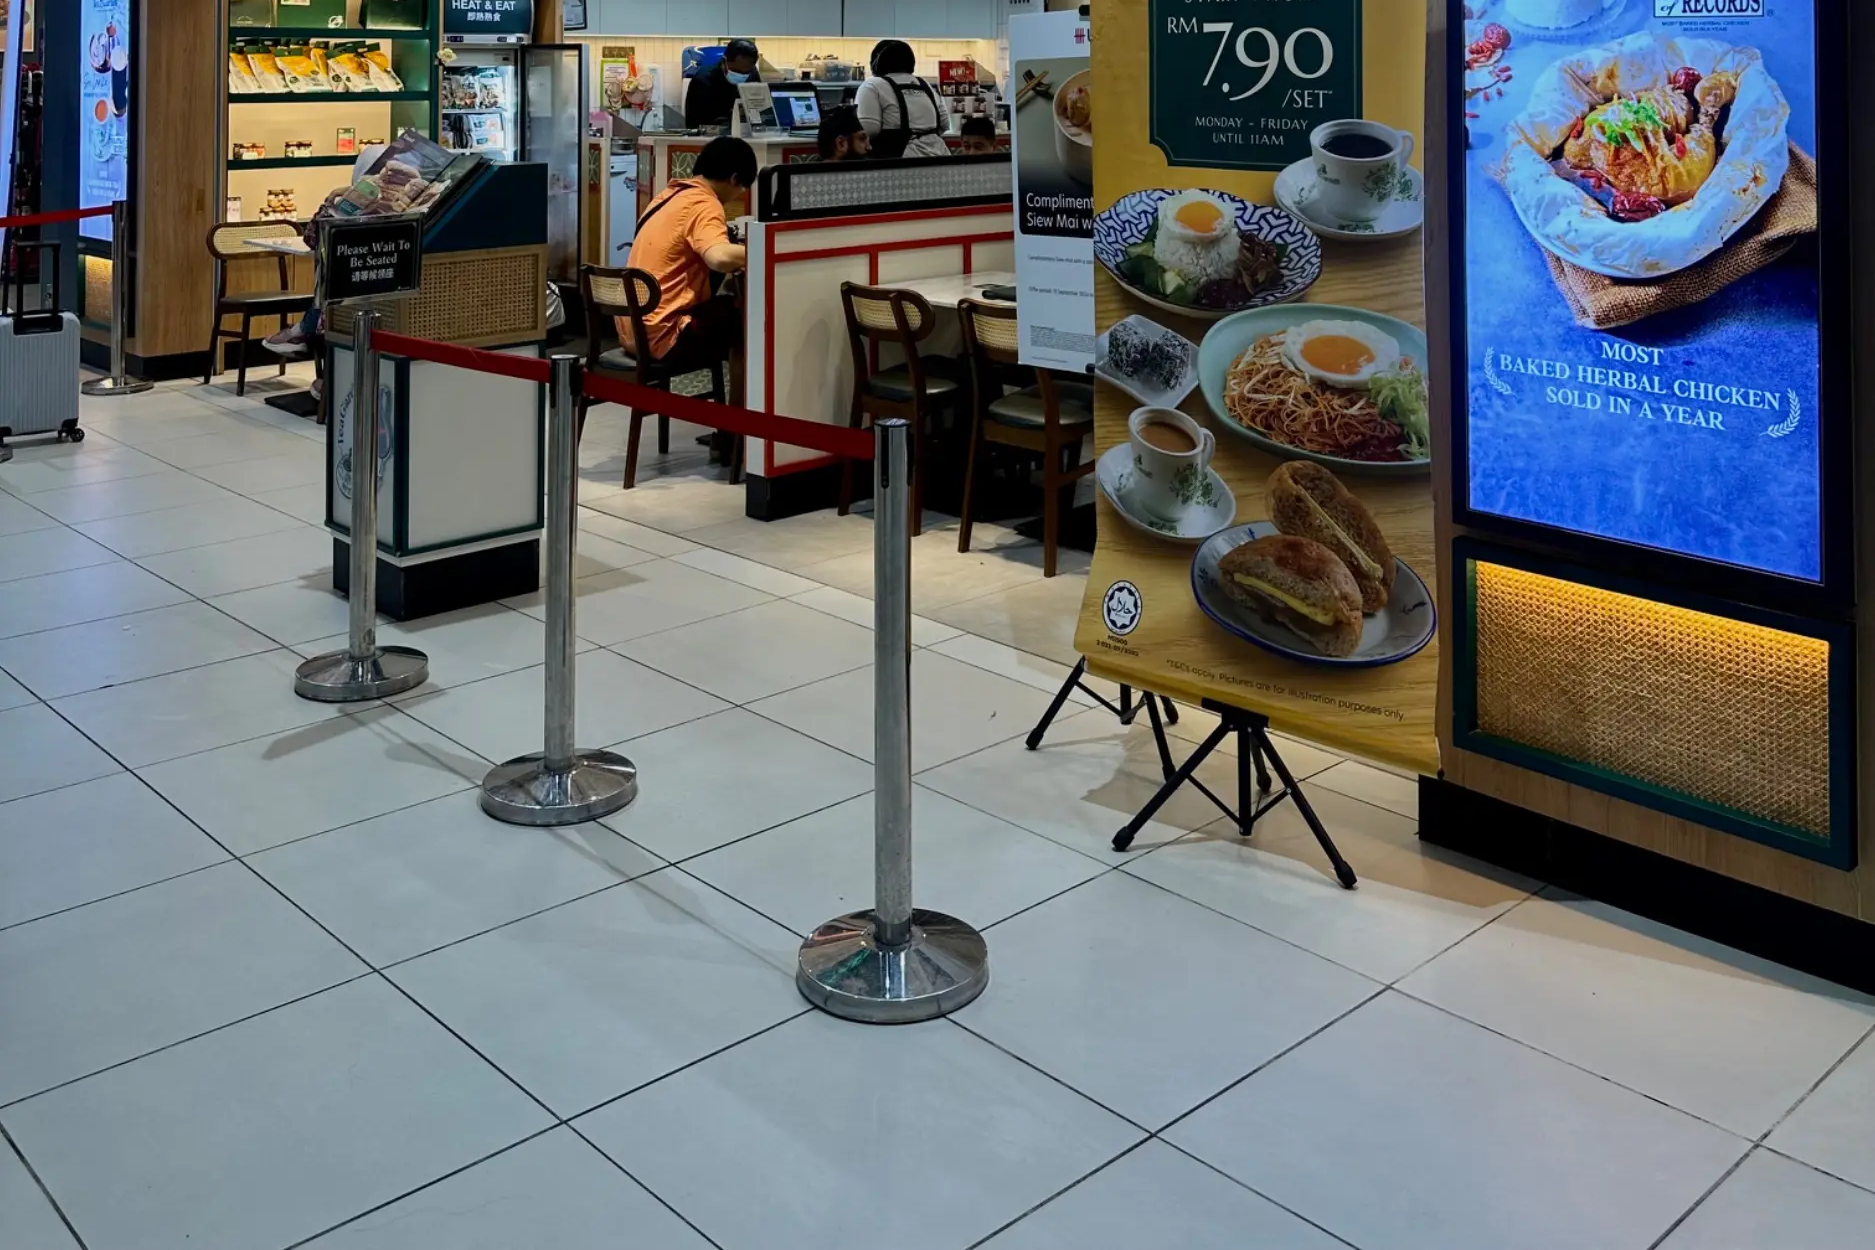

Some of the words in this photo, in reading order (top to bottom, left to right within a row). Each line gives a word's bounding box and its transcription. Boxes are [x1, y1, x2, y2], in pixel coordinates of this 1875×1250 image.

[452, 0, 482, 10] HEAT
[484, 0, 493, 10] &
[495, 0, 516, 11] EAT
[1167, 17, 1198, 34] RM
[1203, 22, 1334, 101] 7.90
[1195, 116, 1243, 128] MONDAY
[1261, 118, 1308, 130] FRIDAY
[1213, 133, 1244, 144] UNTIL
[1251, 135, 1284, 145] 11AM
[1026, 192, 1094, 211] Compliment
[1026, 212, 1053, 228] Siew
[1056, 214, 1079, 229] Mai
[337, 244, 369, 256] Please
[372, 241, 395, 252] Wait
[398, 240, 410, 250] To
[350, 257, 364, 268] Be
[366, 252, 398, 266] Seated
[1601, 341, 1664, 366] MOST
[1500, 354, 1570, 380] BAKED
[1578, 366, 1667, 394] HERBAL
[1673, 379, 1780, 411] CHICKEN
[1546, 386, 1601, 410] SOLD
[1609, 395, 1632, 415] IN
[1638, 399, 1655, 419] A
[1661, 404, 1725, 431] YEAR
[1218, 673, 1253, 688] Pictures
[1256, 682, 1270, 692] are
[1273, 685, 1286, 694] for
[1288, 688, 1336, 704] illustration
[1338, 699, 1382, 715] purposes
[1384, 709, 1404, 722] only
